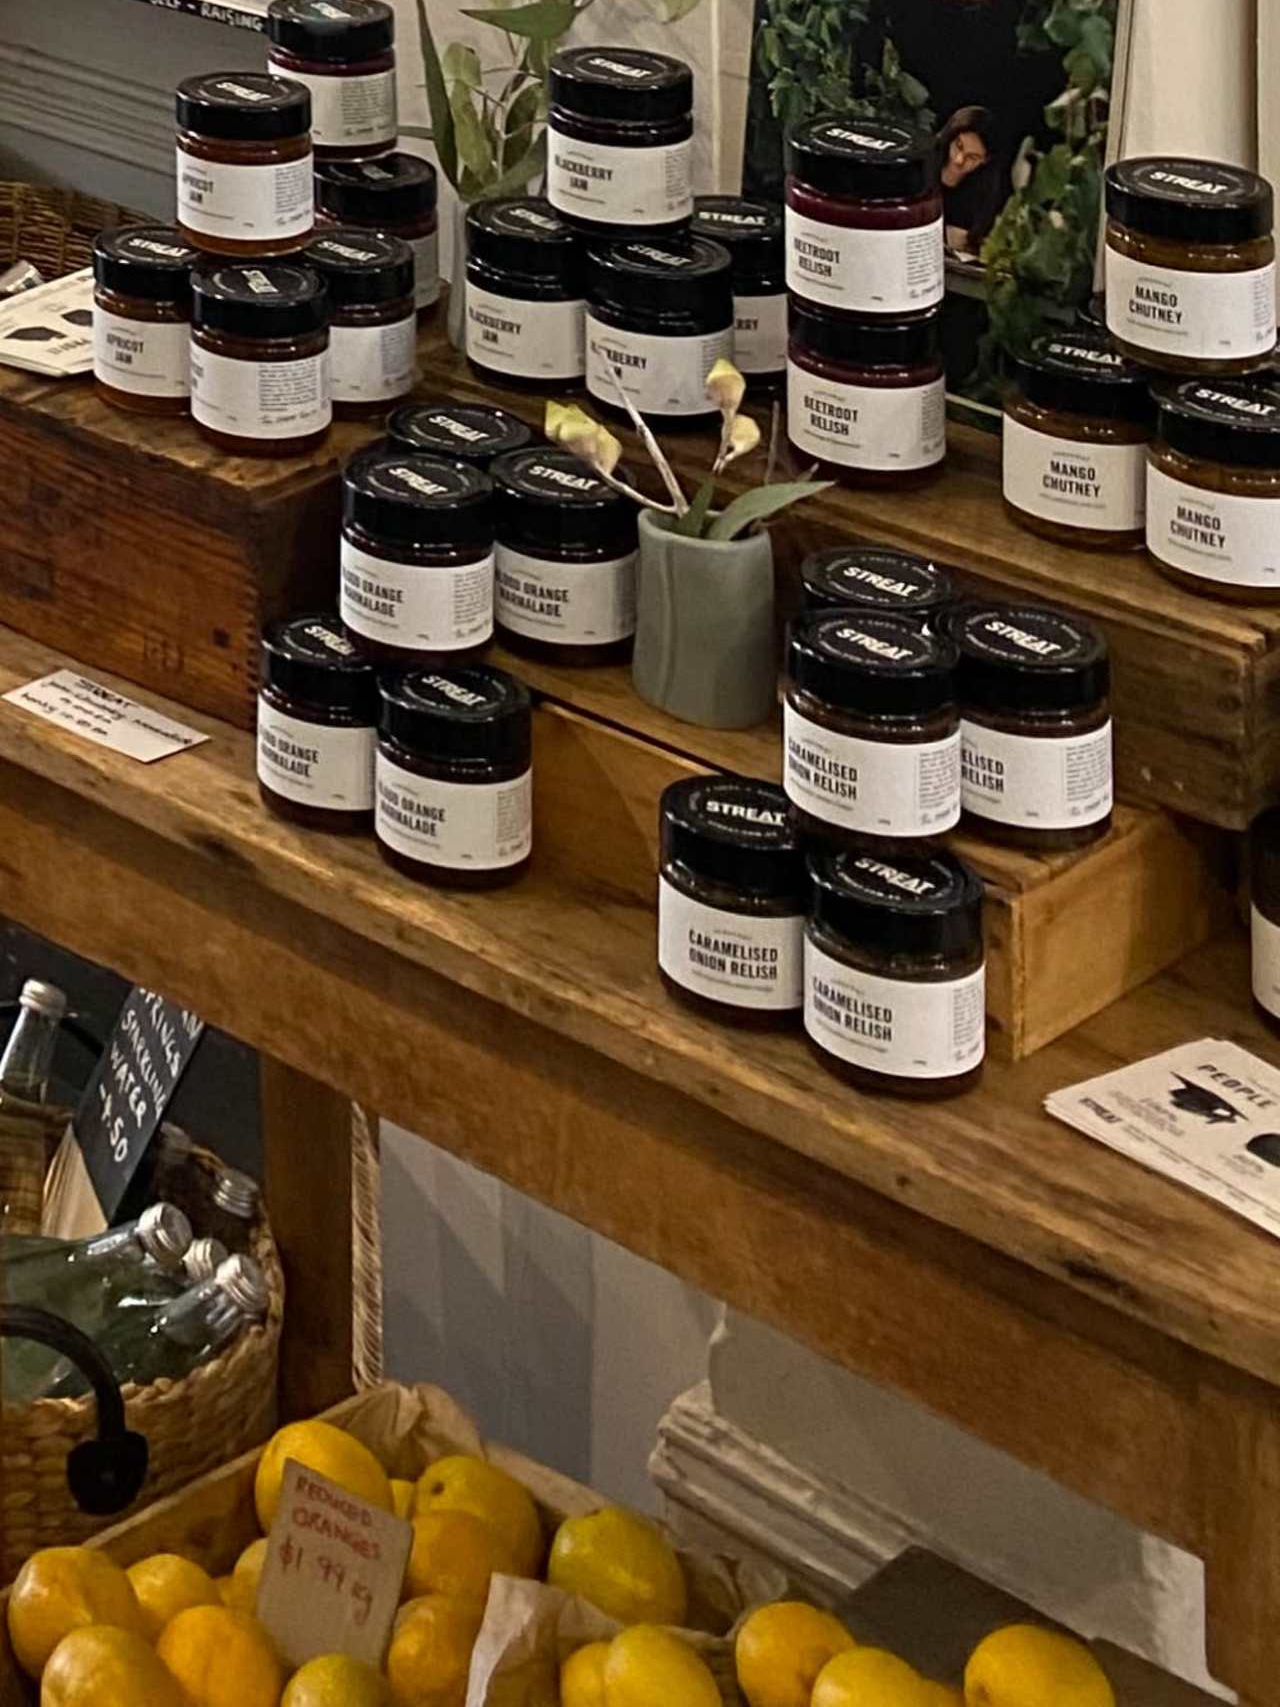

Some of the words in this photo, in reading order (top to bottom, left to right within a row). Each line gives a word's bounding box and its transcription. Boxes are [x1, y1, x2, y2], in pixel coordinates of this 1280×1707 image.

[199, 1, 265, 34] RAISING
[587, 55, 654, 79] STREAT
[216, 81, 273, 104] STREAT
[824, 127, 897, 152] STREAT
[554, 153, 614, 182] BLACKBERRY
[1149, 169, 1228, 195] STREAT
[569, 175, 589, 192] JAM
[128, 239, 191, 261] STREAT
[793, 237, 841, 265] BEETROOT
[796, 253, 834, 278] RELISH
[1133, 283, 1180, 309] MANGO
[1127, 300, 1184, 326] CHUTNEY
[106, 332, 145, 354] APRICOT
[1048, 342, 1124, 368] STREAT
[115, 350, 134, 366] JAM
[803, 394, 860, 423] BEETROOT
[1195, 387, 1278, 416] STREAT
[429, 413, 491, 443] STREAT
[809, 412, 850, 437] RELISH
[388, 464, 449, 495] STREAT
[528, 463, 600, 491] STREAT
[1049, 458, 1098, 482] MANGO
[1041, 474, 1102, 499] CHUTNEY
[1176, 504, 1223, 531] MANGO
[1169, 520, 1227, 550] CHUTNEY
[361, 577, 404, 605] ORANGE
[522, 578, 570, 603] ORANGE
[842, 564, 920, 598] STREAT
[836, 625, 913, 662] STREAT
[983, 618, 1062, 657] STREAT
[420, 673, 489, 706] STREAT
[277, 735, 320, 765] ORANGE
[787, 736, 859, 783] CARAMELISED
[813, 773, 859, 801] RELISH
[400, 792, 446, 823] ORANGE
[705, 798, 785, 828] STREAT
[852, 856, 936, 896] STREAT
[688, 928, 779, 964] CARAMELISED
[688, 946, 728, 977] ONION
[729, 956, 779, 982] RELISH
[811, 974, 894, 1024] CARAMELISED
[843, 1014, 894, 1044] RELISH
[121, 1008, 167, 1121] SPARKLING
[110, 1041, 148, 1129] WATER
[1197, 1063, 1279, 1110] PEOPLE
[295, 1475, 372, 1527] REDUCED
[292, 1506, 381, 1561] ORANGES
